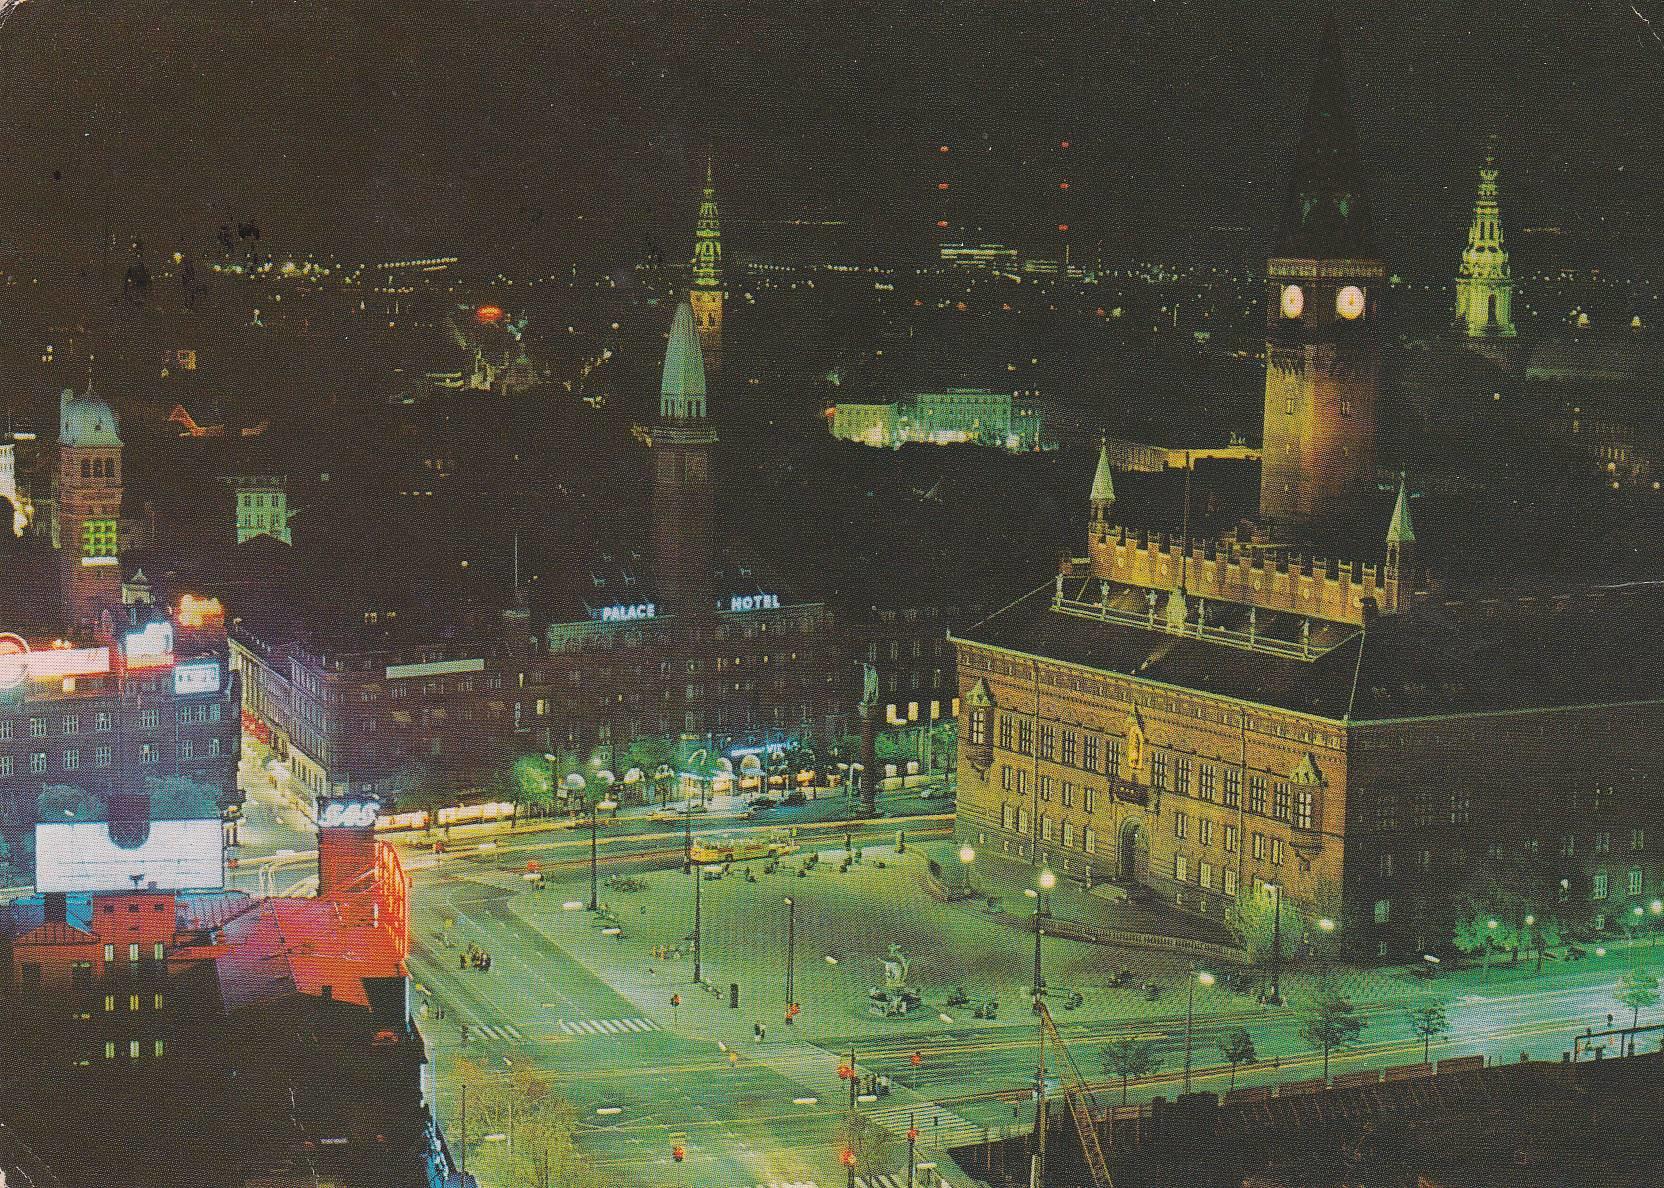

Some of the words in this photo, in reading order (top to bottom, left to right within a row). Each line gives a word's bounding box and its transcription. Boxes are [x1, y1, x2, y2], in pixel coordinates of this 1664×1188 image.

[602, 603, 656, 621] PALACE
[731, 594, 781, 612] HOTEL
[318, 803, 380, 827] SAS
